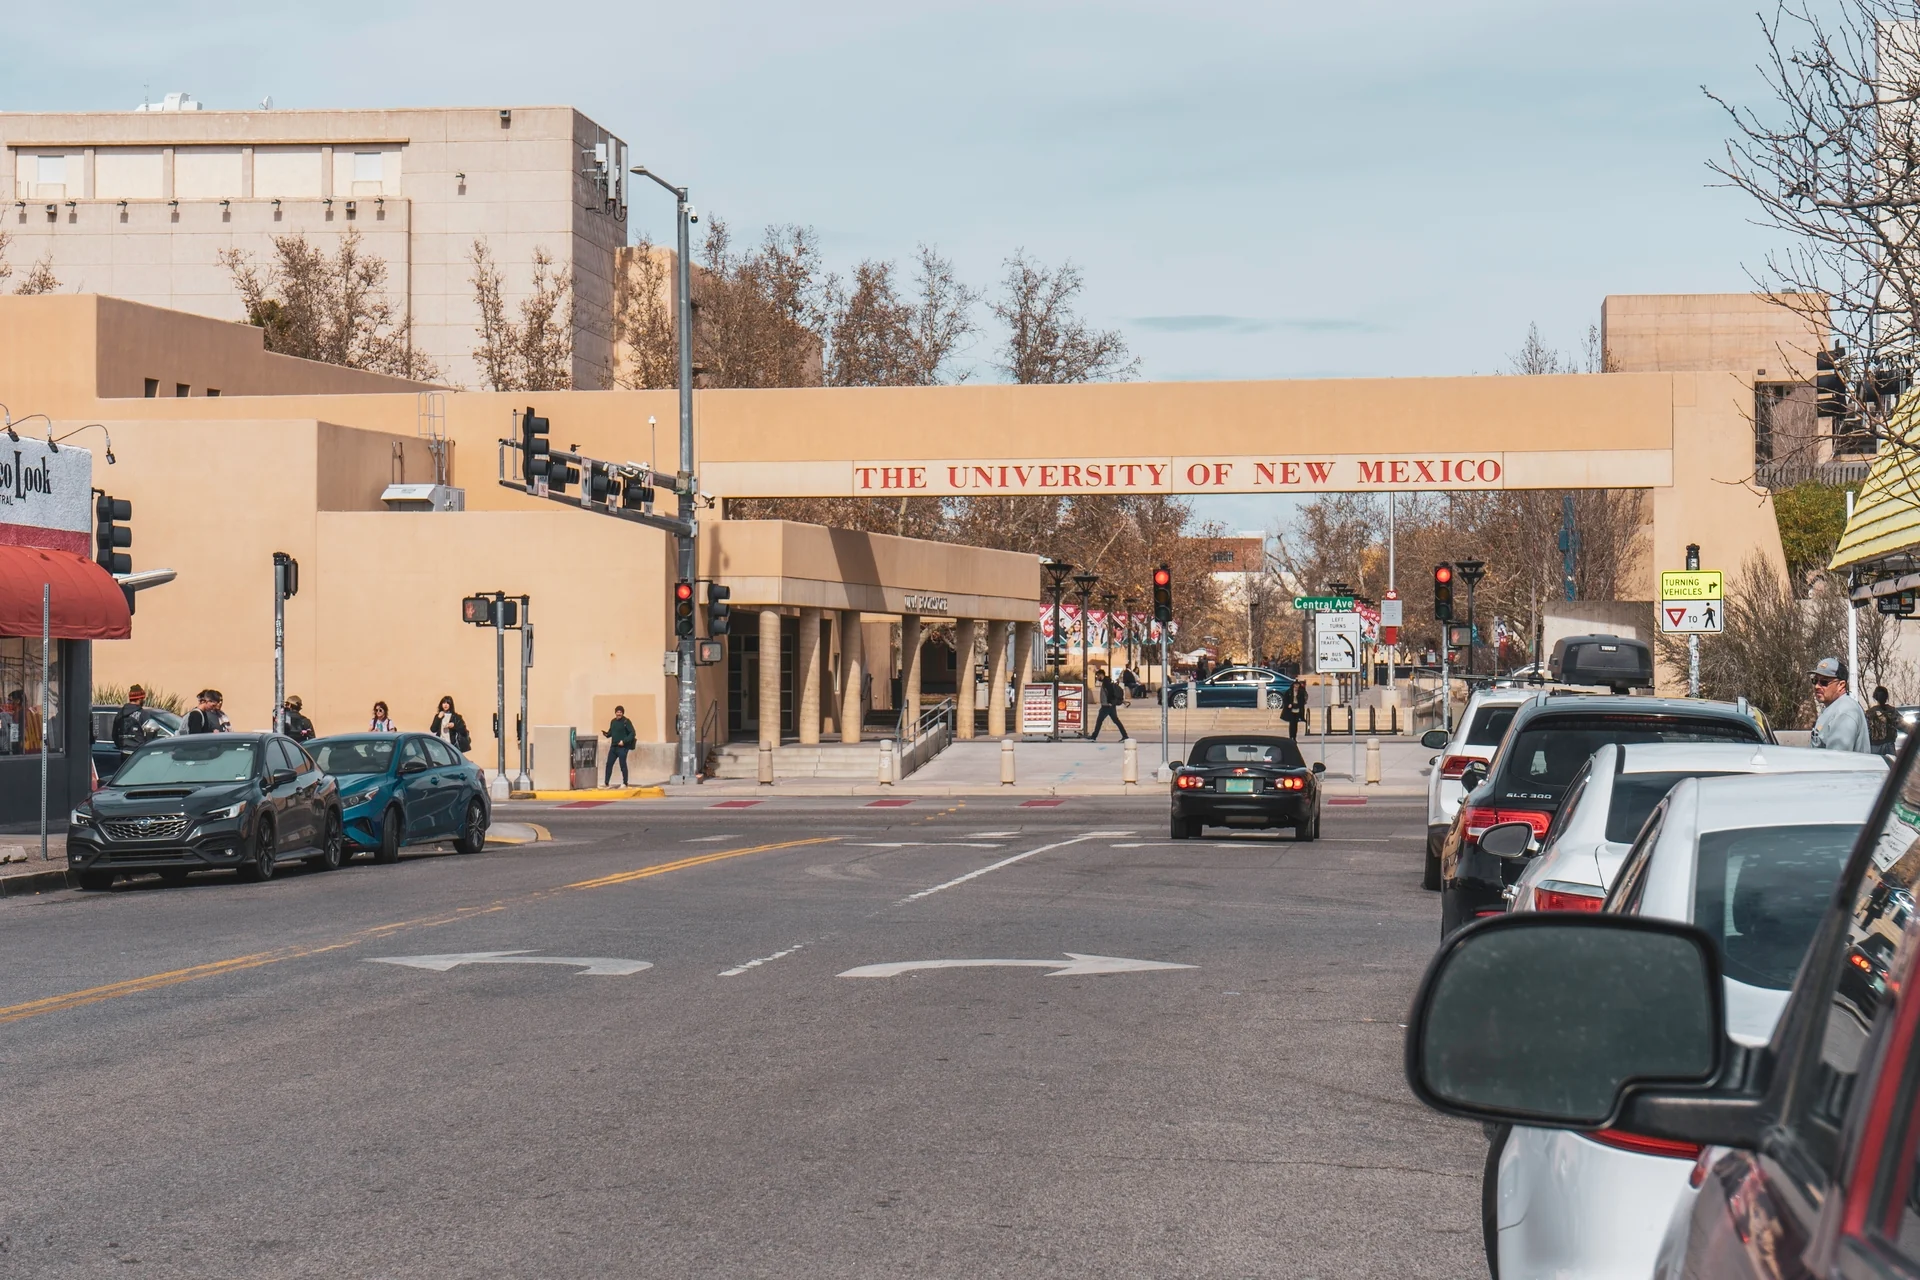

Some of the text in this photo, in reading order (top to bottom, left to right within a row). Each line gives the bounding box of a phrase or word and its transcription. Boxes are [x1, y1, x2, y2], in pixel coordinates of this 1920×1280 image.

[14, 450, 52, 502] Look
[855, 459, 1502, 489] THE UNIVERSITY OF NEW MEXICO
[0, 494, 13, 506] RAL
[1294, 598, 1353, 609] Central Ave
